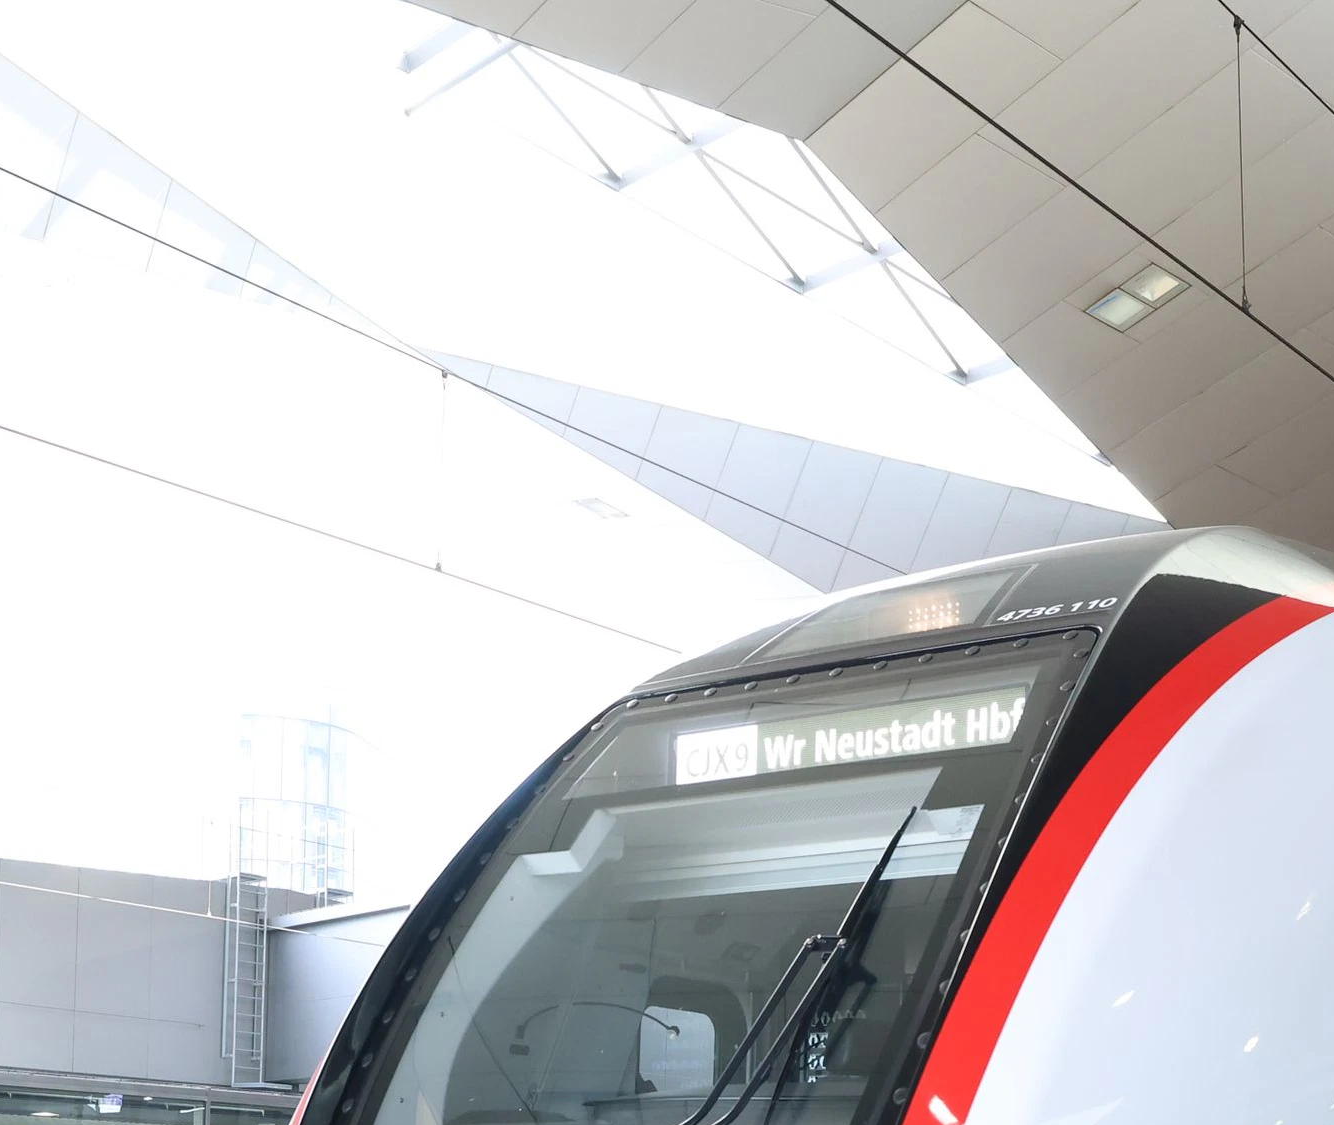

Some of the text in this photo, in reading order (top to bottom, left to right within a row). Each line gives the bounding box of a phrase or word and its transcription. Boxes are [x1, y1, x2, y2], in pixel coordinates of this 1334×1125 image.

[997, 597, 1118, 624] 4736 110
[763, 734, 806, 769] Wr
[815, 709, 956, 763] Neustadt
[967, 697, 1025, 743] Hbf
